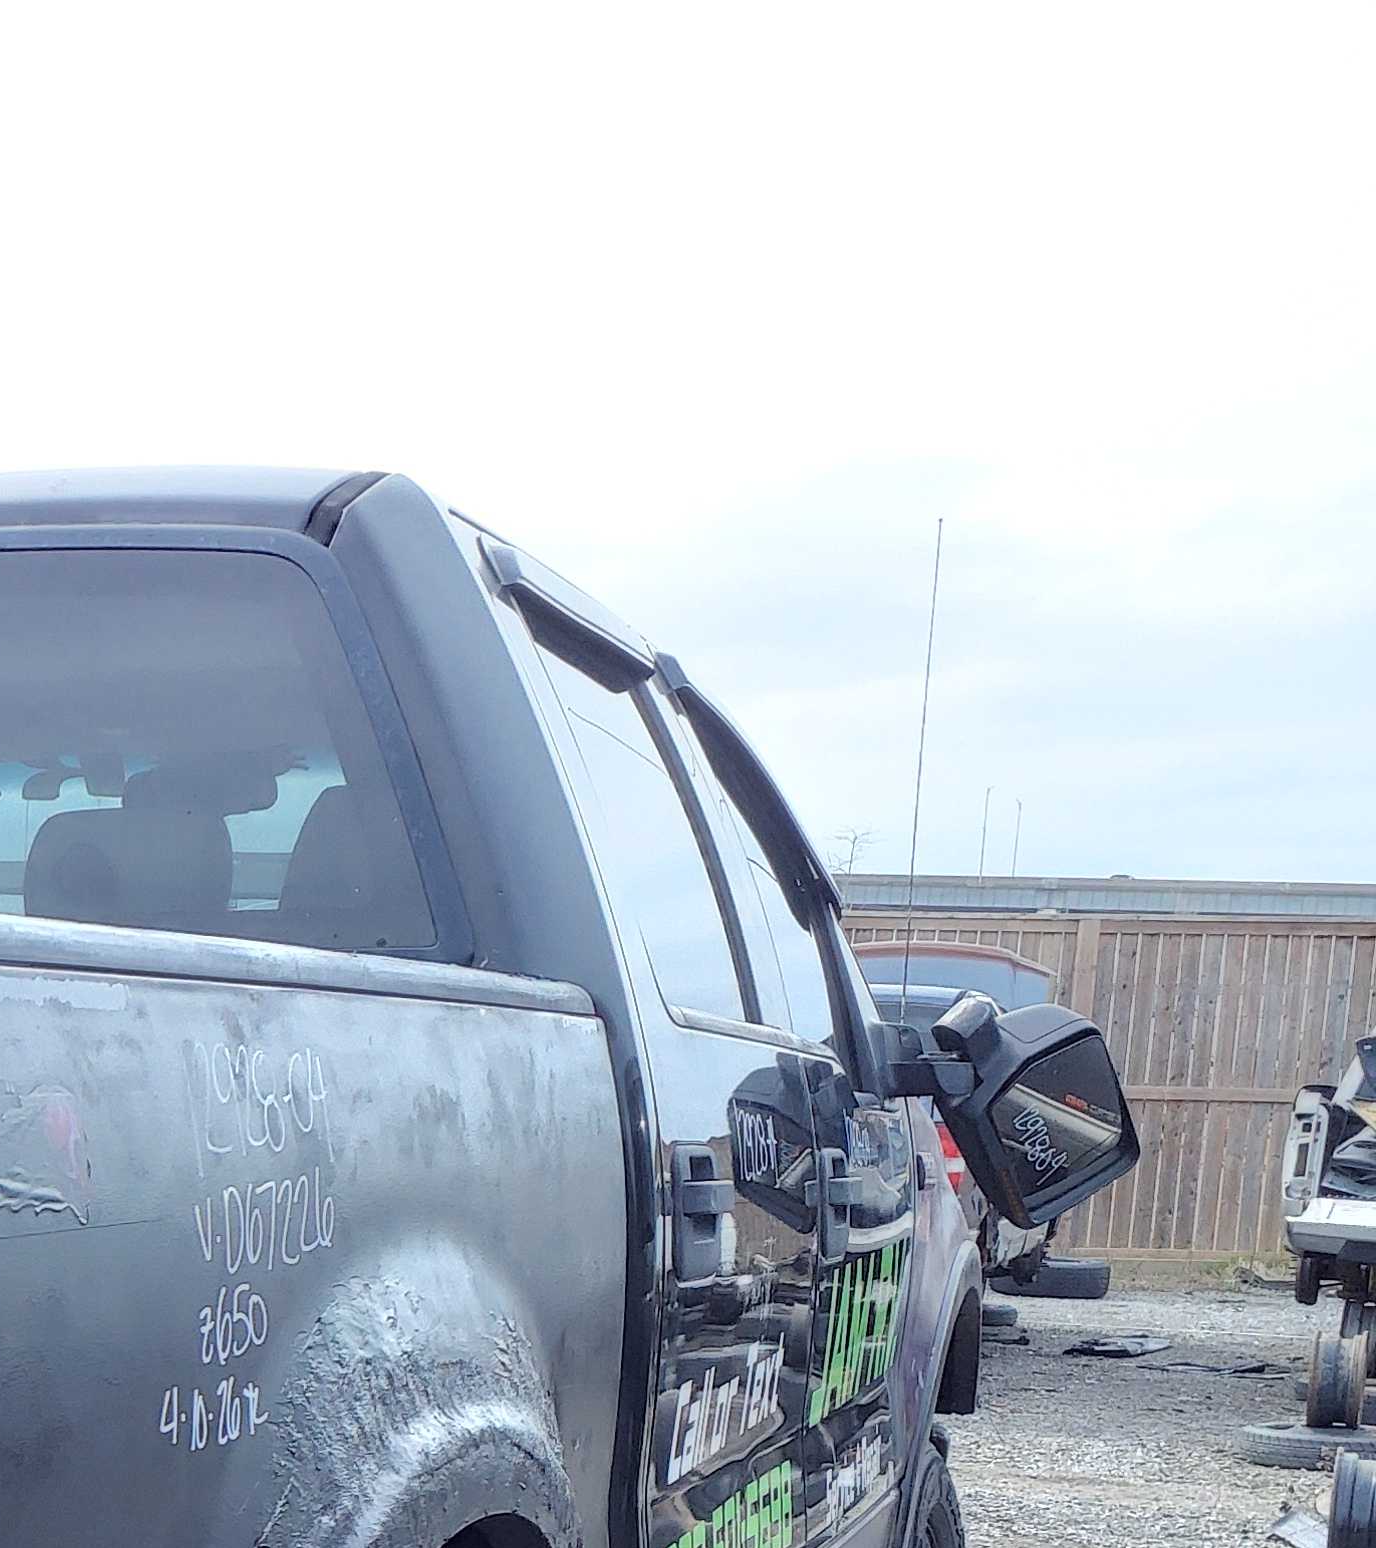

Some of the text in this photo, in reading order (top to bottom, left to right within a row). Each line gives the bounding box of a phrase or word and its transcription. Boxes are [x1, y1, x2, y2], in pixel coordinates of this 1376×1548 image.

[667, 1331, 785, 1486] Call or Text
